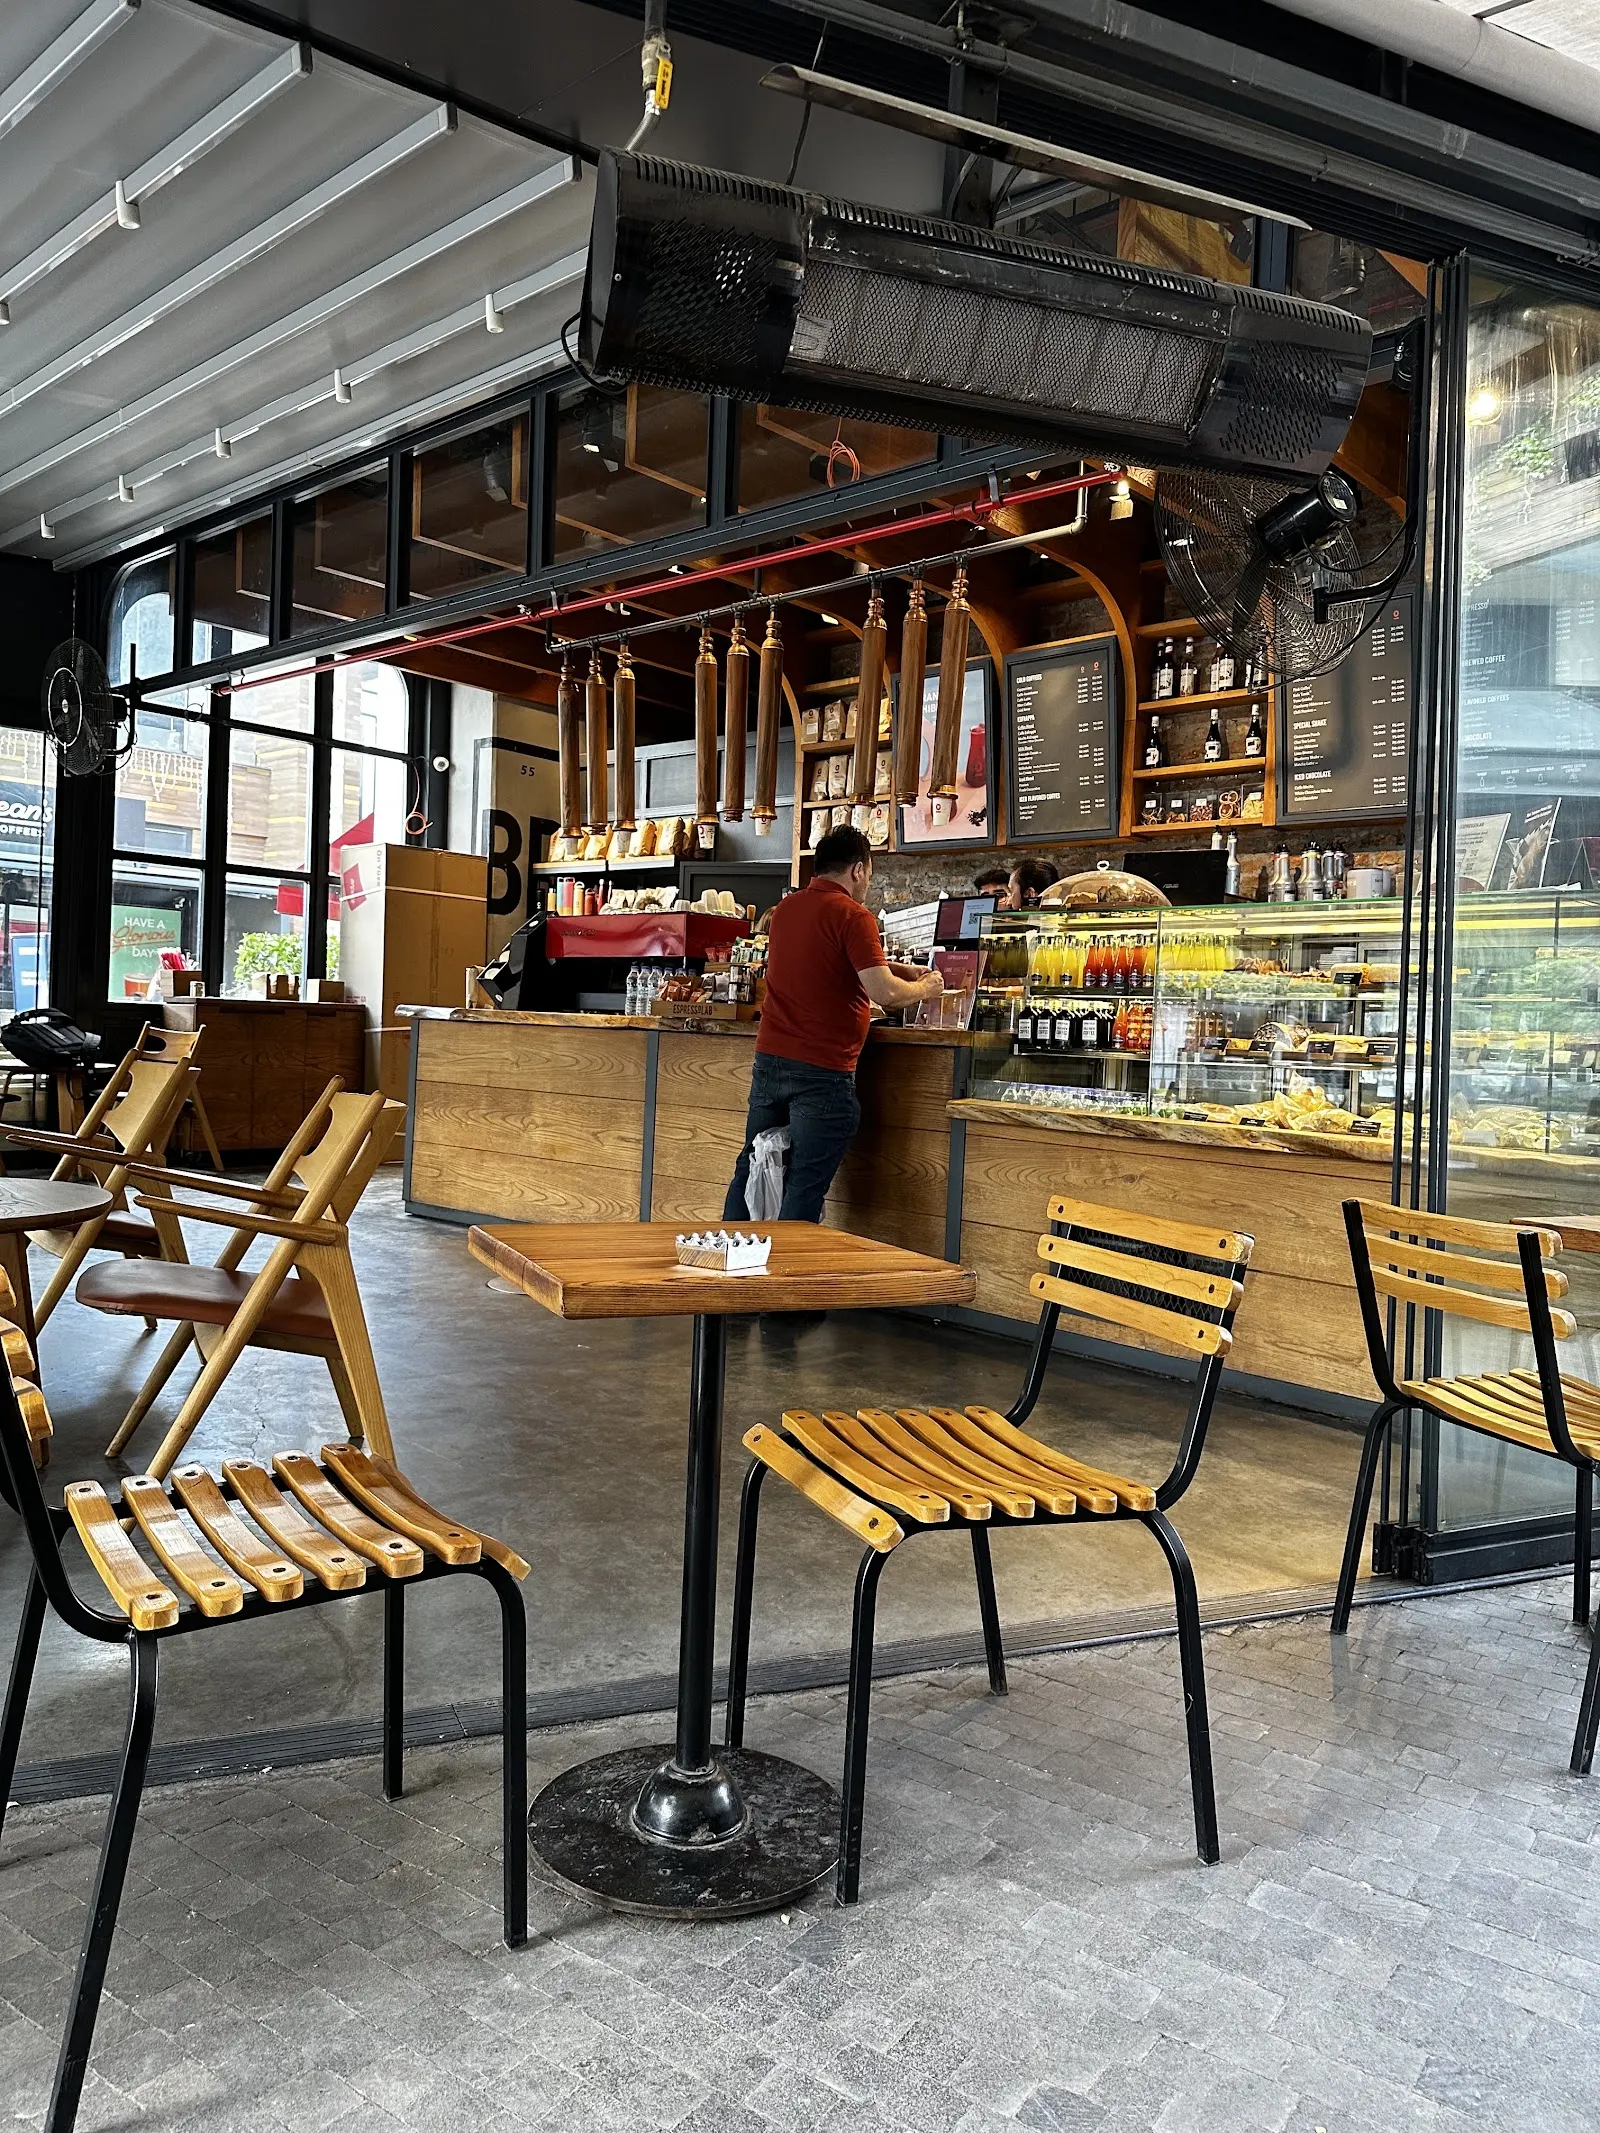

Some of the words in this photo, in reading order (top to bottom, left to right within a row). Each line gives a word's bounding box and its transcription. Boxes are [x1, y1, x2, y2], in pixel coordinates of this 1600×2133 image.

[1485, 654, 1506, 664] COFFEE
[521, 765, 536, 777] 55
[124, 916, 155, 928] HAVE
[156, 920, 166, 929] A
